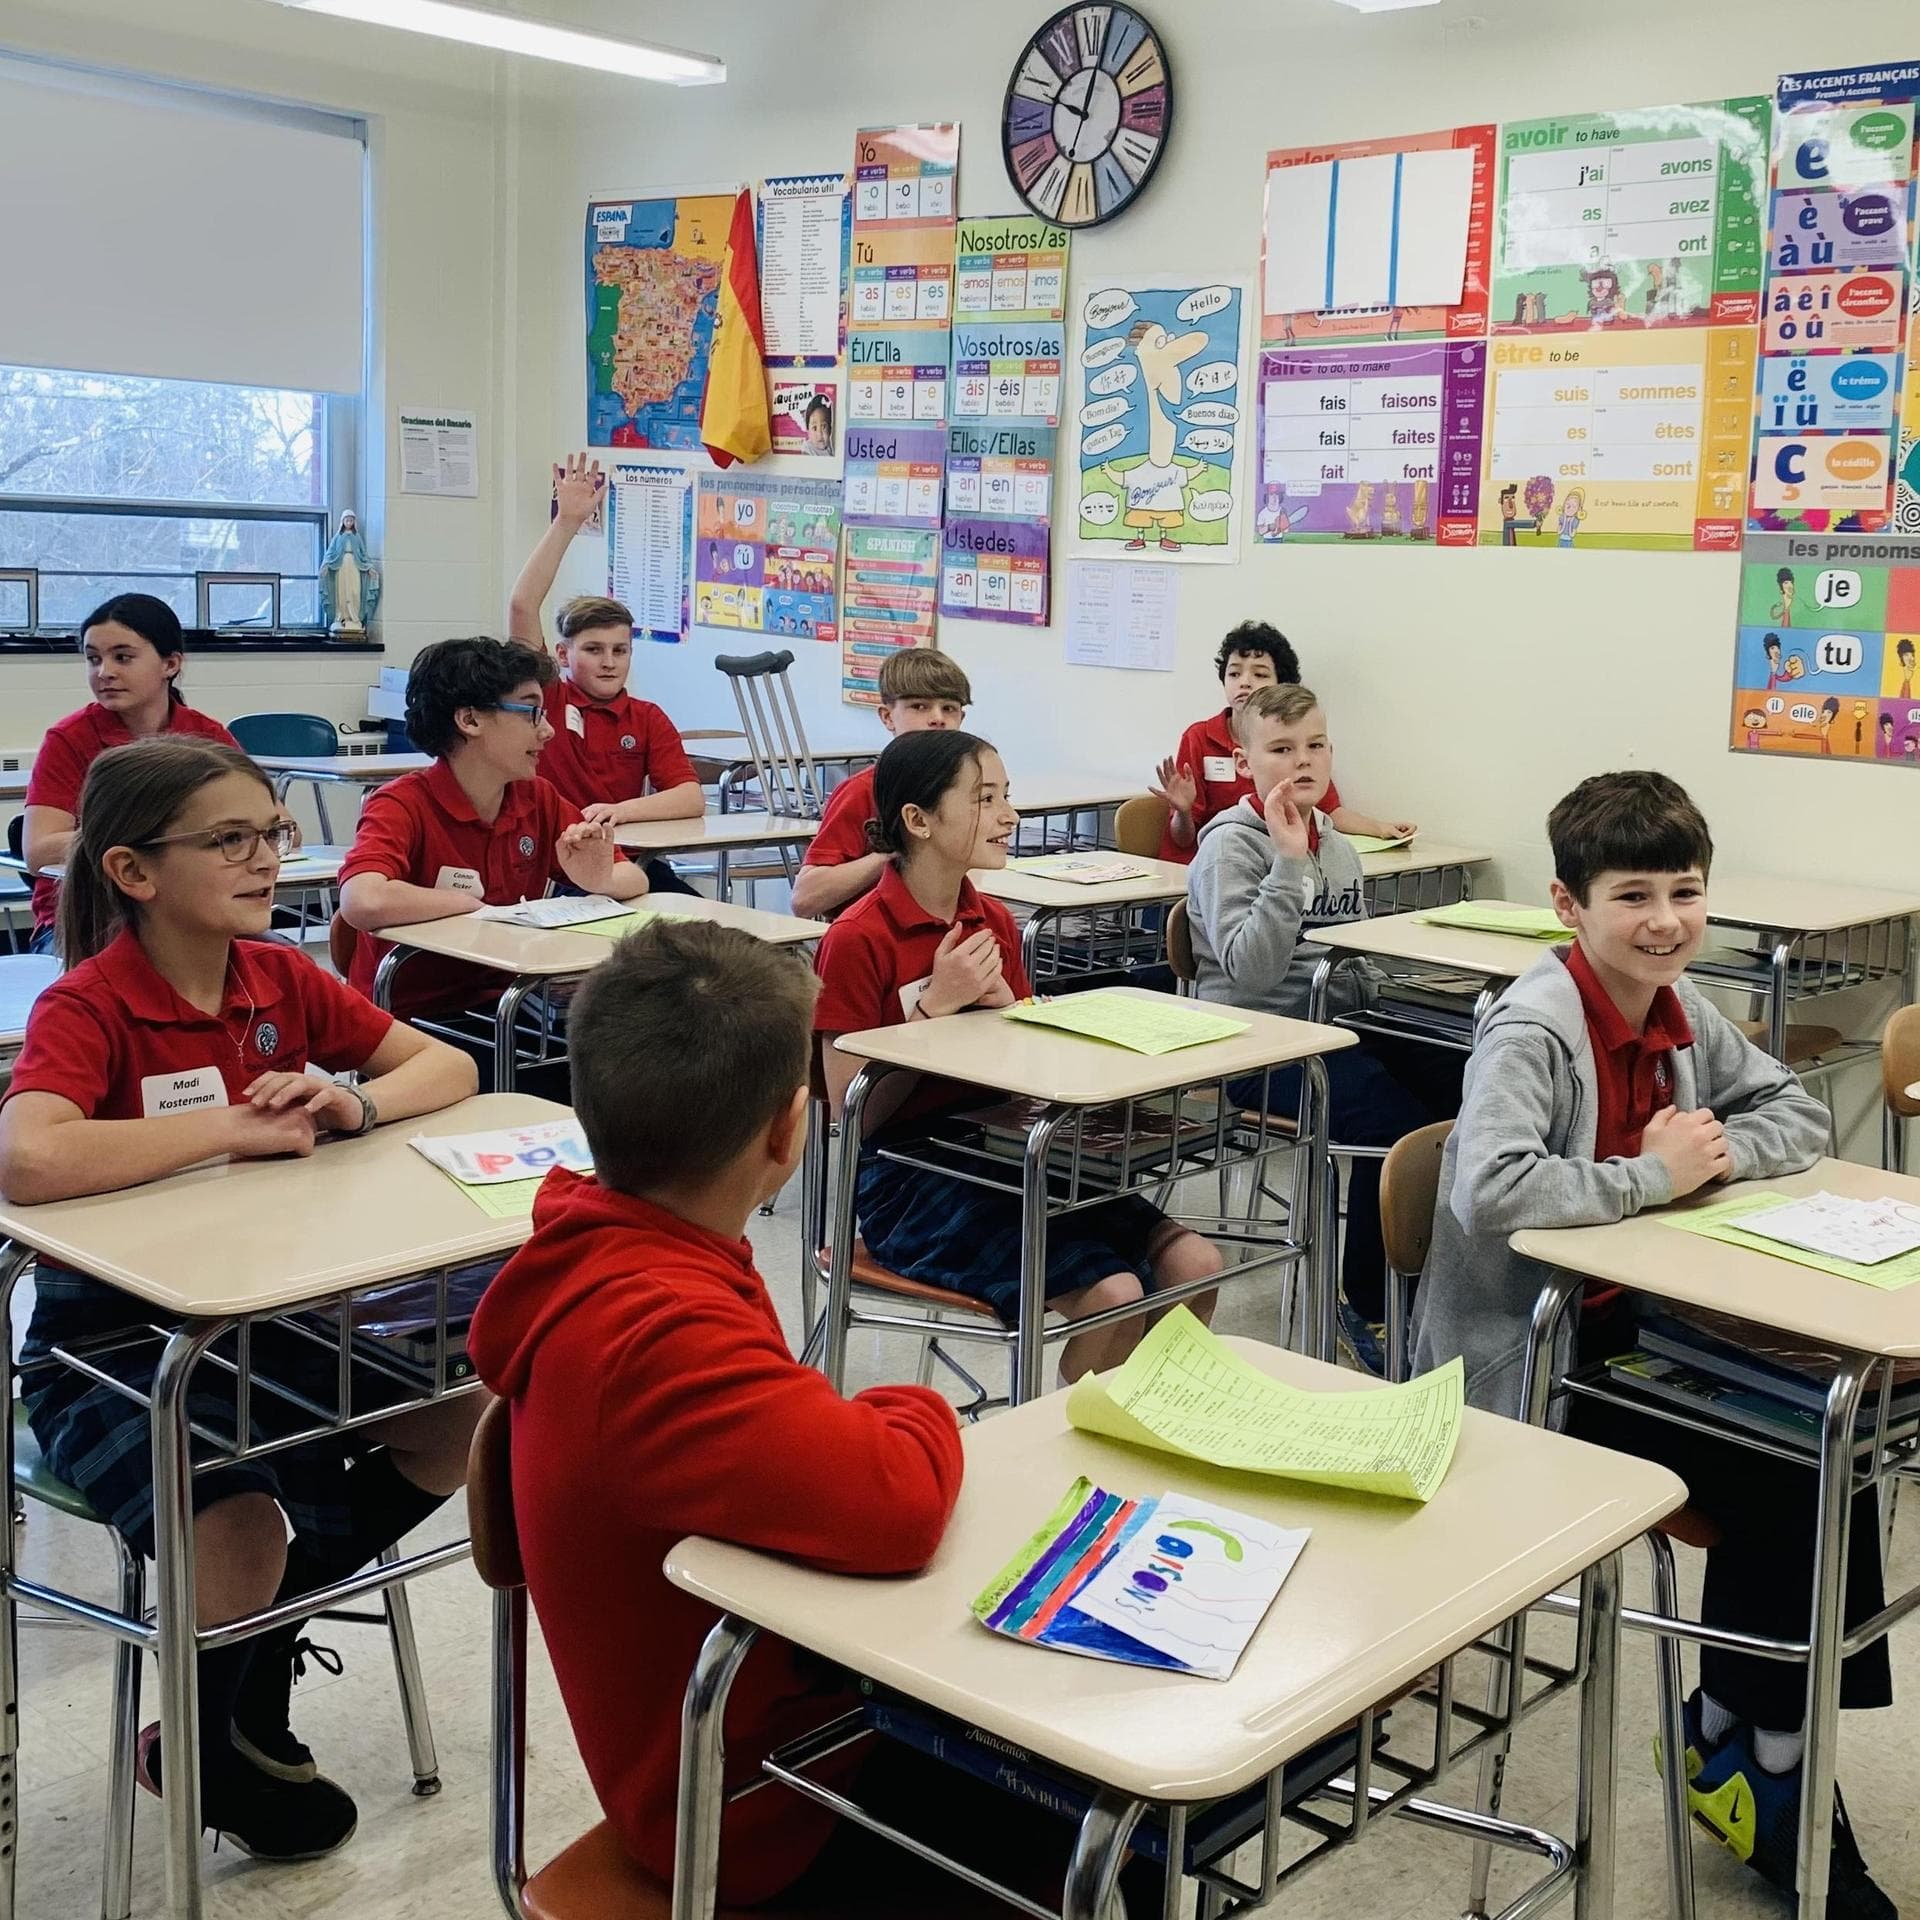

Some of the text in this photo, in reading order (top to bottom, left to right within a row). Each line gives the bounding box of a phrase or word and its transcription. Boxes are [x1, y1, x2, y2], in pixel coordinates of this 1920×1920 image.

[1804, 74, 1856, 90] ACCENTS
[1859, 68, 1920, 84] FRANÇAIS
[1815, 86, 1882, 99] French Accents
[1505, 123, 1621, 150] avoir to have
[860, 142, 877, 163] Yo
[1660, 158, 1713, 175] avons
[1579, 165, 1604, 186] j'ai
[774, 185, 819, 196] Vocabulario
[896, 184, 911, 197] -o
[1582, 207, 1602, 221] as
[1669, 199, 1710, 215] avez
[1798, 198, 1818, 229] è
[1855, 206, 1888, 215] l'accent
[1858, 218, 1884, 227] grave
[961, 225, 1067, 252] Nosotros/as
[1678, 235, 1707, 252] ont
[857, 242, 873, 264] Tú
[859, 287, 879, 300] -as
[890, 286, 911, 299] -es
[923, 285, 944, 298] -es
[1190, 294, 1221, 312] Hello
[852, 337, 901, 362] Él/Ella
[958, 334, 1060, 356] Vosotros/as
[1494, 343, 1580, 364] être to be
[1262, 356, 1313, 377] faire
[1317, 363, 1328, 374] to
[1349, 362, 1359, 373] to
[1362, 361, 1391, 372] make
[859, 386, 872, 399] -a
[890, 386, 905, 399] -e
[921, 386, 936, 398] -e
[993, 379, 1020, 396] -éis
[1554, 386, 1589, 401] suis
[1619, 384, 1696, 400] sommes
[1320, 395, 1346, 410] fais
[1381, 393, 1437, 408] faisons
[1187, 409, 1216, 419] Buenos
[1392, 429, 1435, 444] faites
[1567, 427, 1586, 439] es
[1655, 422, 1695, 438] êtes
[951, 431, 1036, 455] Ellos/Ellas
[1319, 431, 1345, 446] fais
[848, 436, 897, 459] Usted
[1321, 464, 1344, 479] fait
[1403, 464, 1434, 479] font
[1559, 461, 1586, 476] est
[1653, 460, 1692, 476] sont
[626, 474, 638, 482] Los
[954, 478, 976, 491] -an
[985, 479, 1010, 492] -en
[700, 477, 841, 498] los pronombres personales
[916, 484, 931, 496] -e
[738, 503, 753, 521] yo
[866, 537, 916, 551] SPANISH
[946, 526, 1016, 553] Ustedes
[1788, 539, 1920, 561] les pronoms
[949, 573, 972, 586] -an
[981, 575, 1006, 590] -en
[1014, 579, 1038, 592] -en
[1824, 574, 1851, 603] je
[1825, 641, 1851, 666] tu
[1771, 700, 1779, 711] il
[1792, 707, 1815, 719] elle
[173, 1077, 200, 1090] Madi
[159, 1093, 215, 1110] Kosterman
